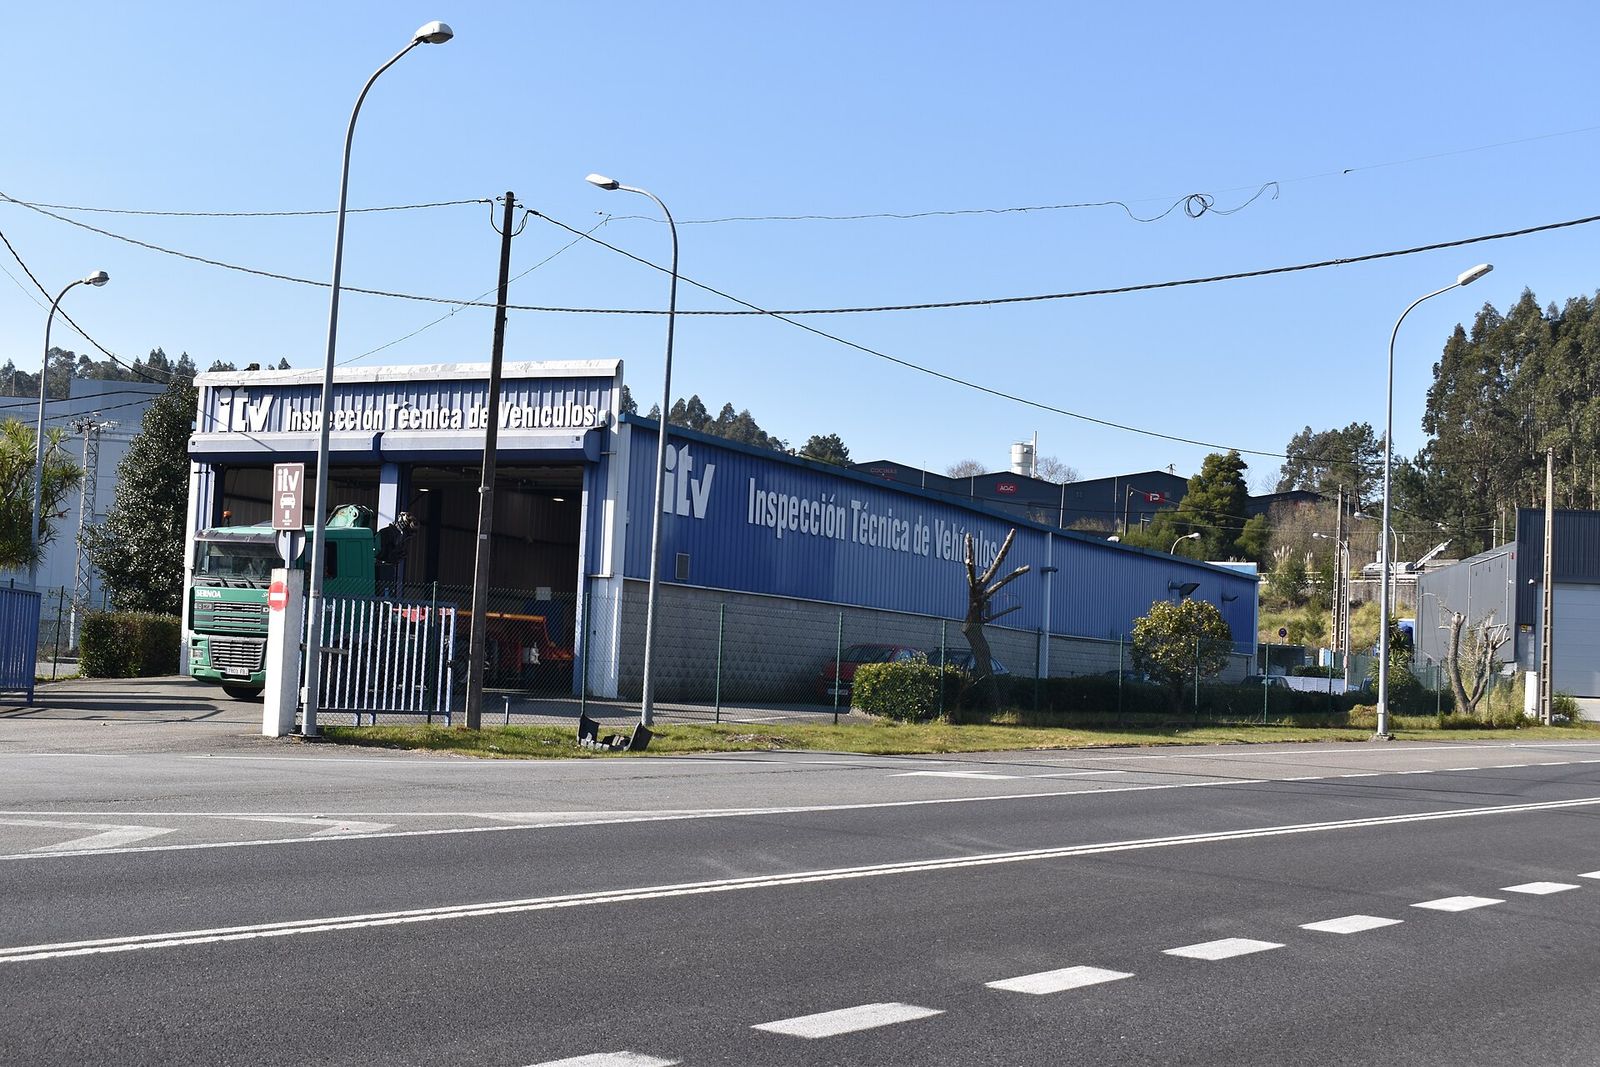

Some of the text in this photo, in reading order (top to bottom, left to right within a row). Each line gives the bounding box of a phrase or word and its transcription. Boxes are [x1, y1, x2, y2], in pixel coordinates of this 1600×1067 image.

[219, 387, 274, 432] itv
[388, 401, 463, 430] Técnica
[469, 402, 489, 429] de
[277, 468, 300, 492] itv
[662, 443, 716, 519] itv
[748, 477, 846, 539] Inspección
[851, 499, 910, 552] Técnica
[913, 515, 930, 557] de
